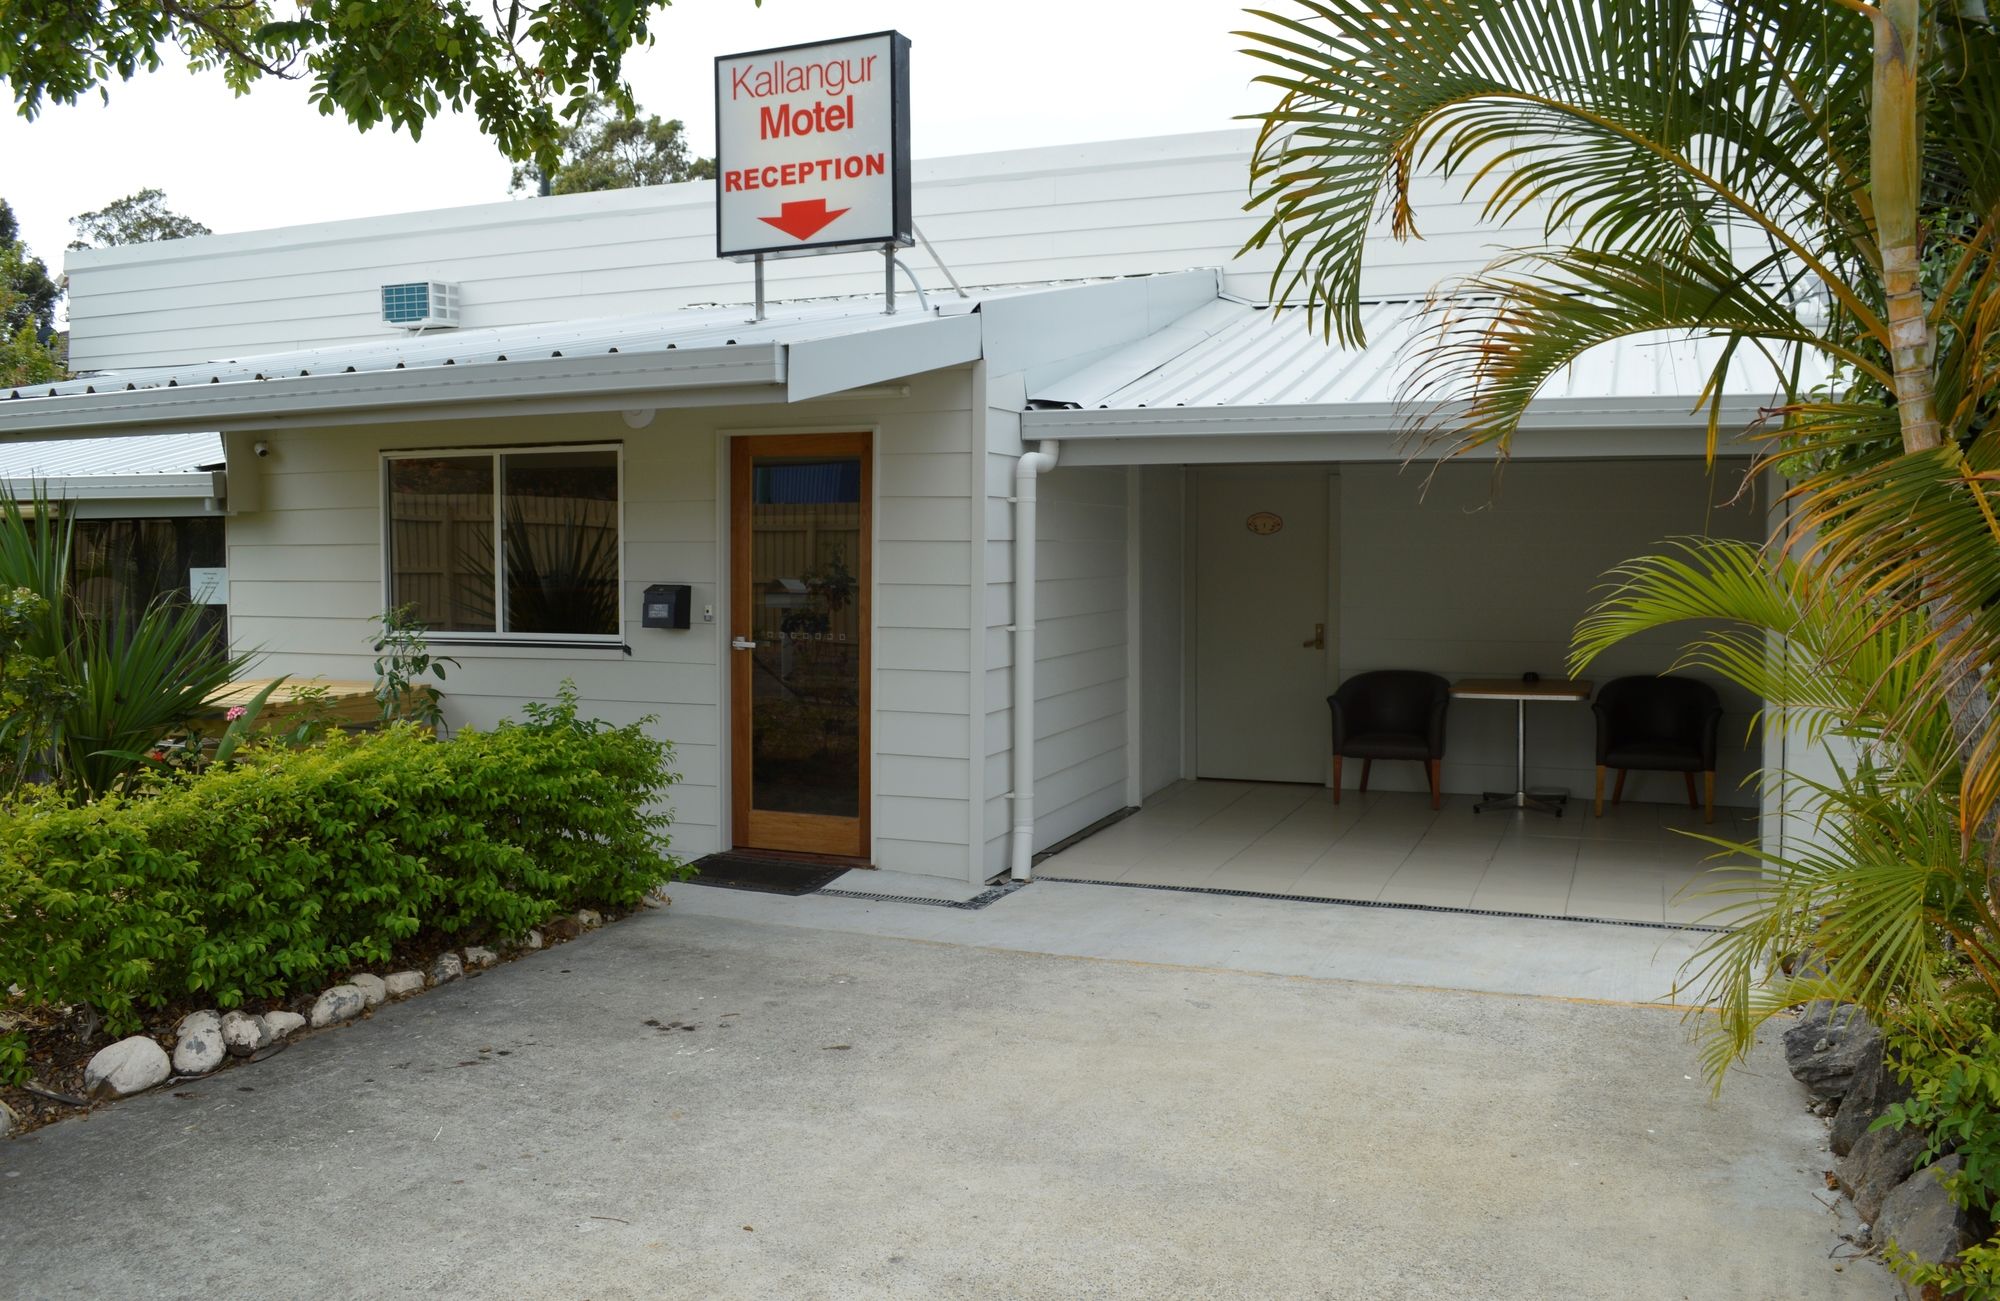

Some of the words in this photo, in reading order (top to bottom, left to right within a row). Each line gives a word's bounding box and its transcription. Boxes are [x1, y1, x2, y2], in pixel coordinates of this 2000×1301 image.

[732, 54, 877, 100] Kallangur
[760, 94, 854, 140] Motel
[725, 153, 885, 193] RECEPTION
